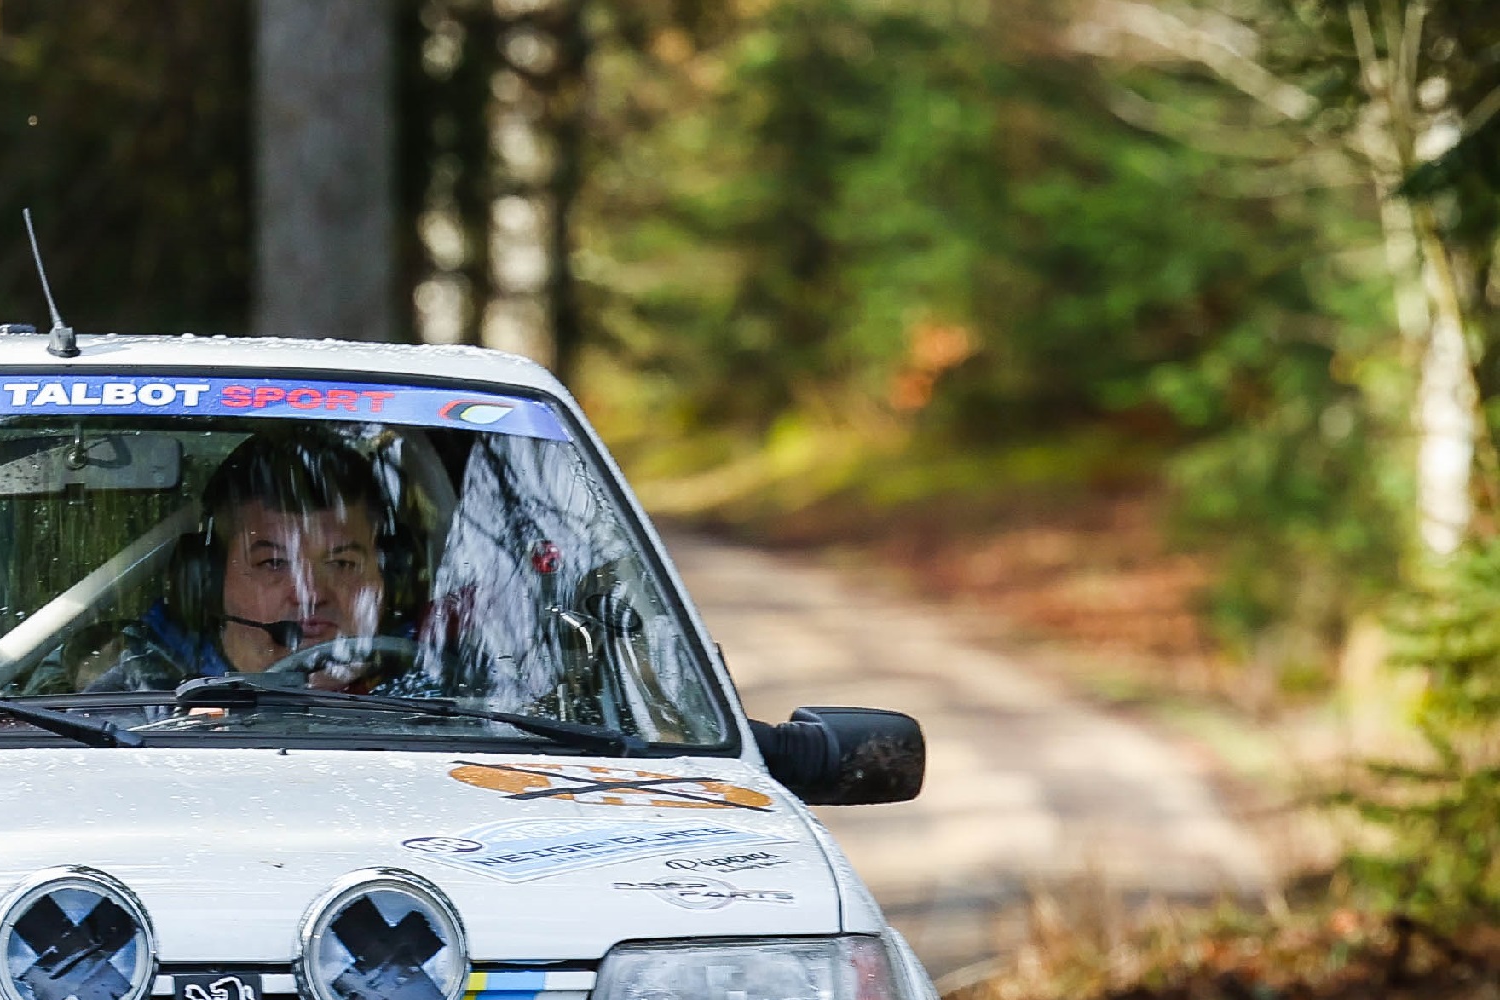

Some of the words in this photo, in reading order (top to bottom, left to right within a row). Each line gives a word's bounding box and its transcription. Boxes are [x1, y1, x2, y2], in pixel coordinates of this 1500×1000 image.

[3, 382, 210, 408] TALBOT
[220, 384, 396, 413] SPORT
[470, 842, 602, 867] NEIGE
